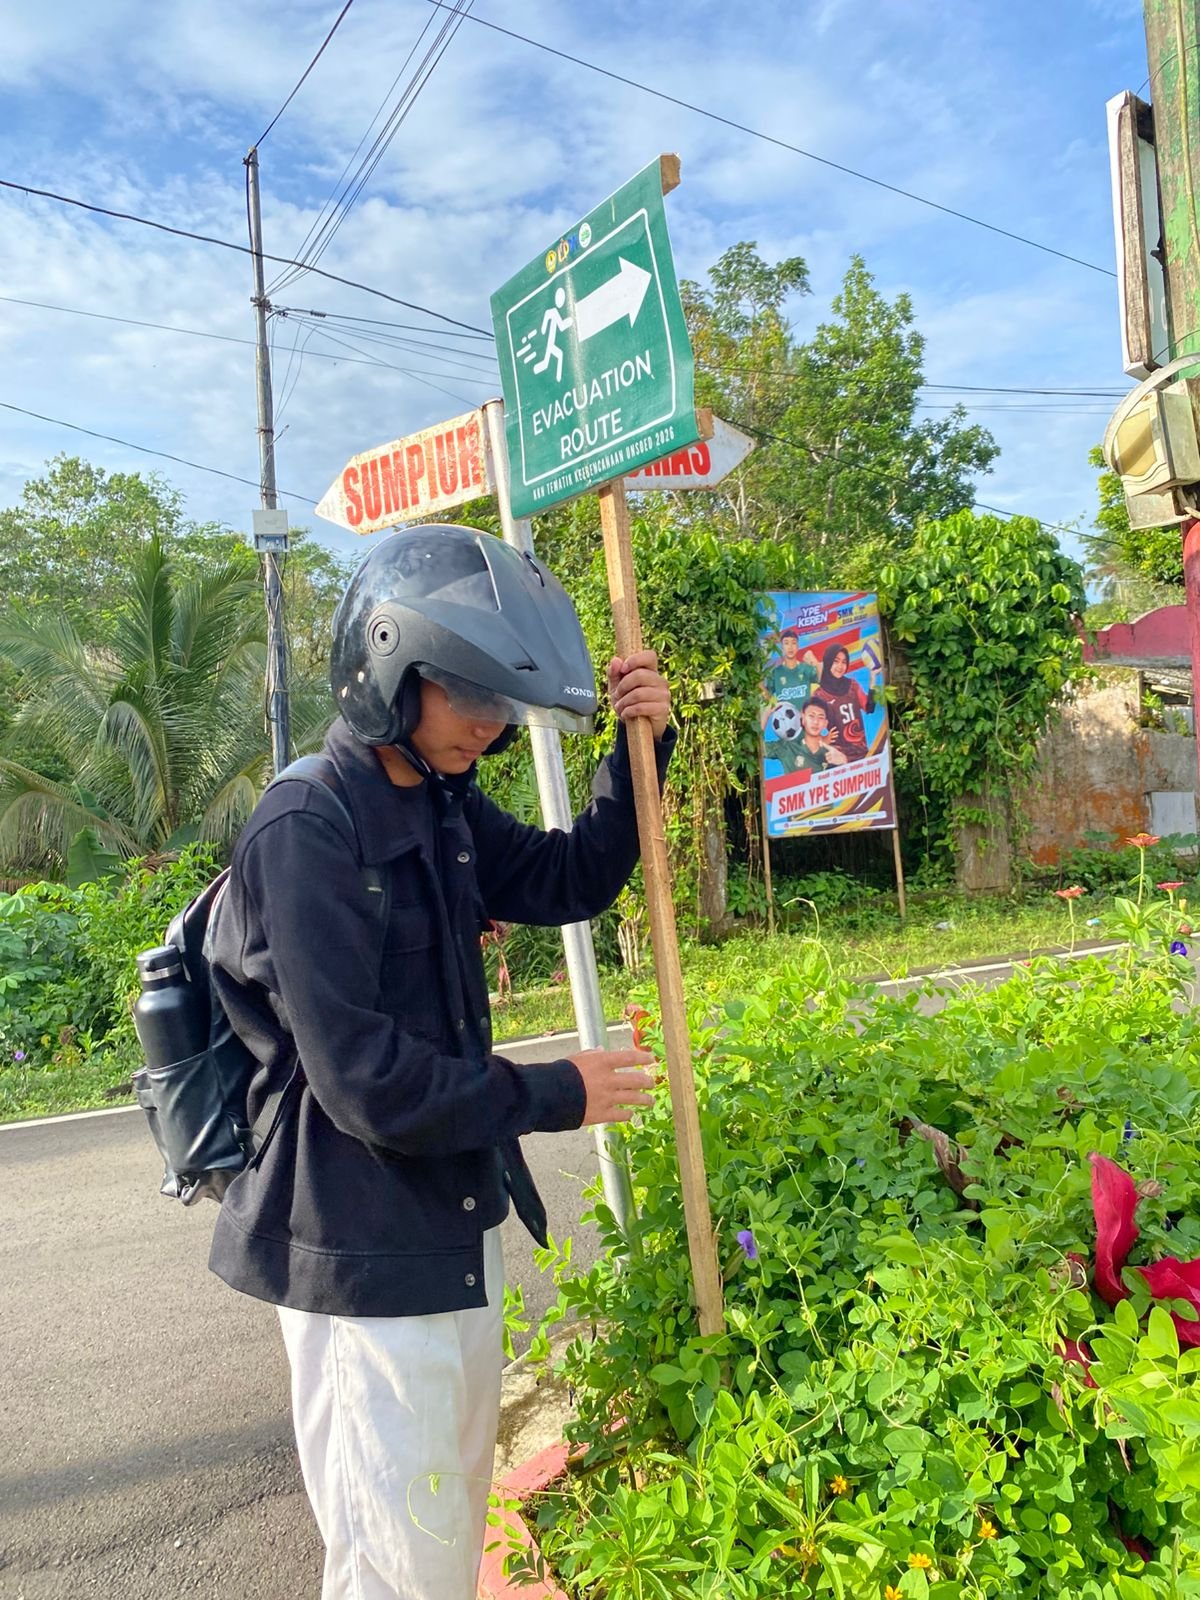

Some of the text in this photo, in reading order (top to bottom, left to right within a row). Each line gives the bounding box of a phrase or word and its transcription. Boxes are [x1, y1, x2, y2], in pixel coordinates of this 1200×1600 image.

[533, 350, 653, 436] EVACUATION
[560, 408, 624, 460] ROUTE
[655, 426, 675, 447] 2026
[798, 611, 828, 628] KEREN
[802, 605, 821, 618] YPE
[779, 685, 807, 700] SPORT
[778, 791, 806, 815] SMK
[809, 783, 830, 806] YPE
[833, 768, 881, 799] SUMPIUH
